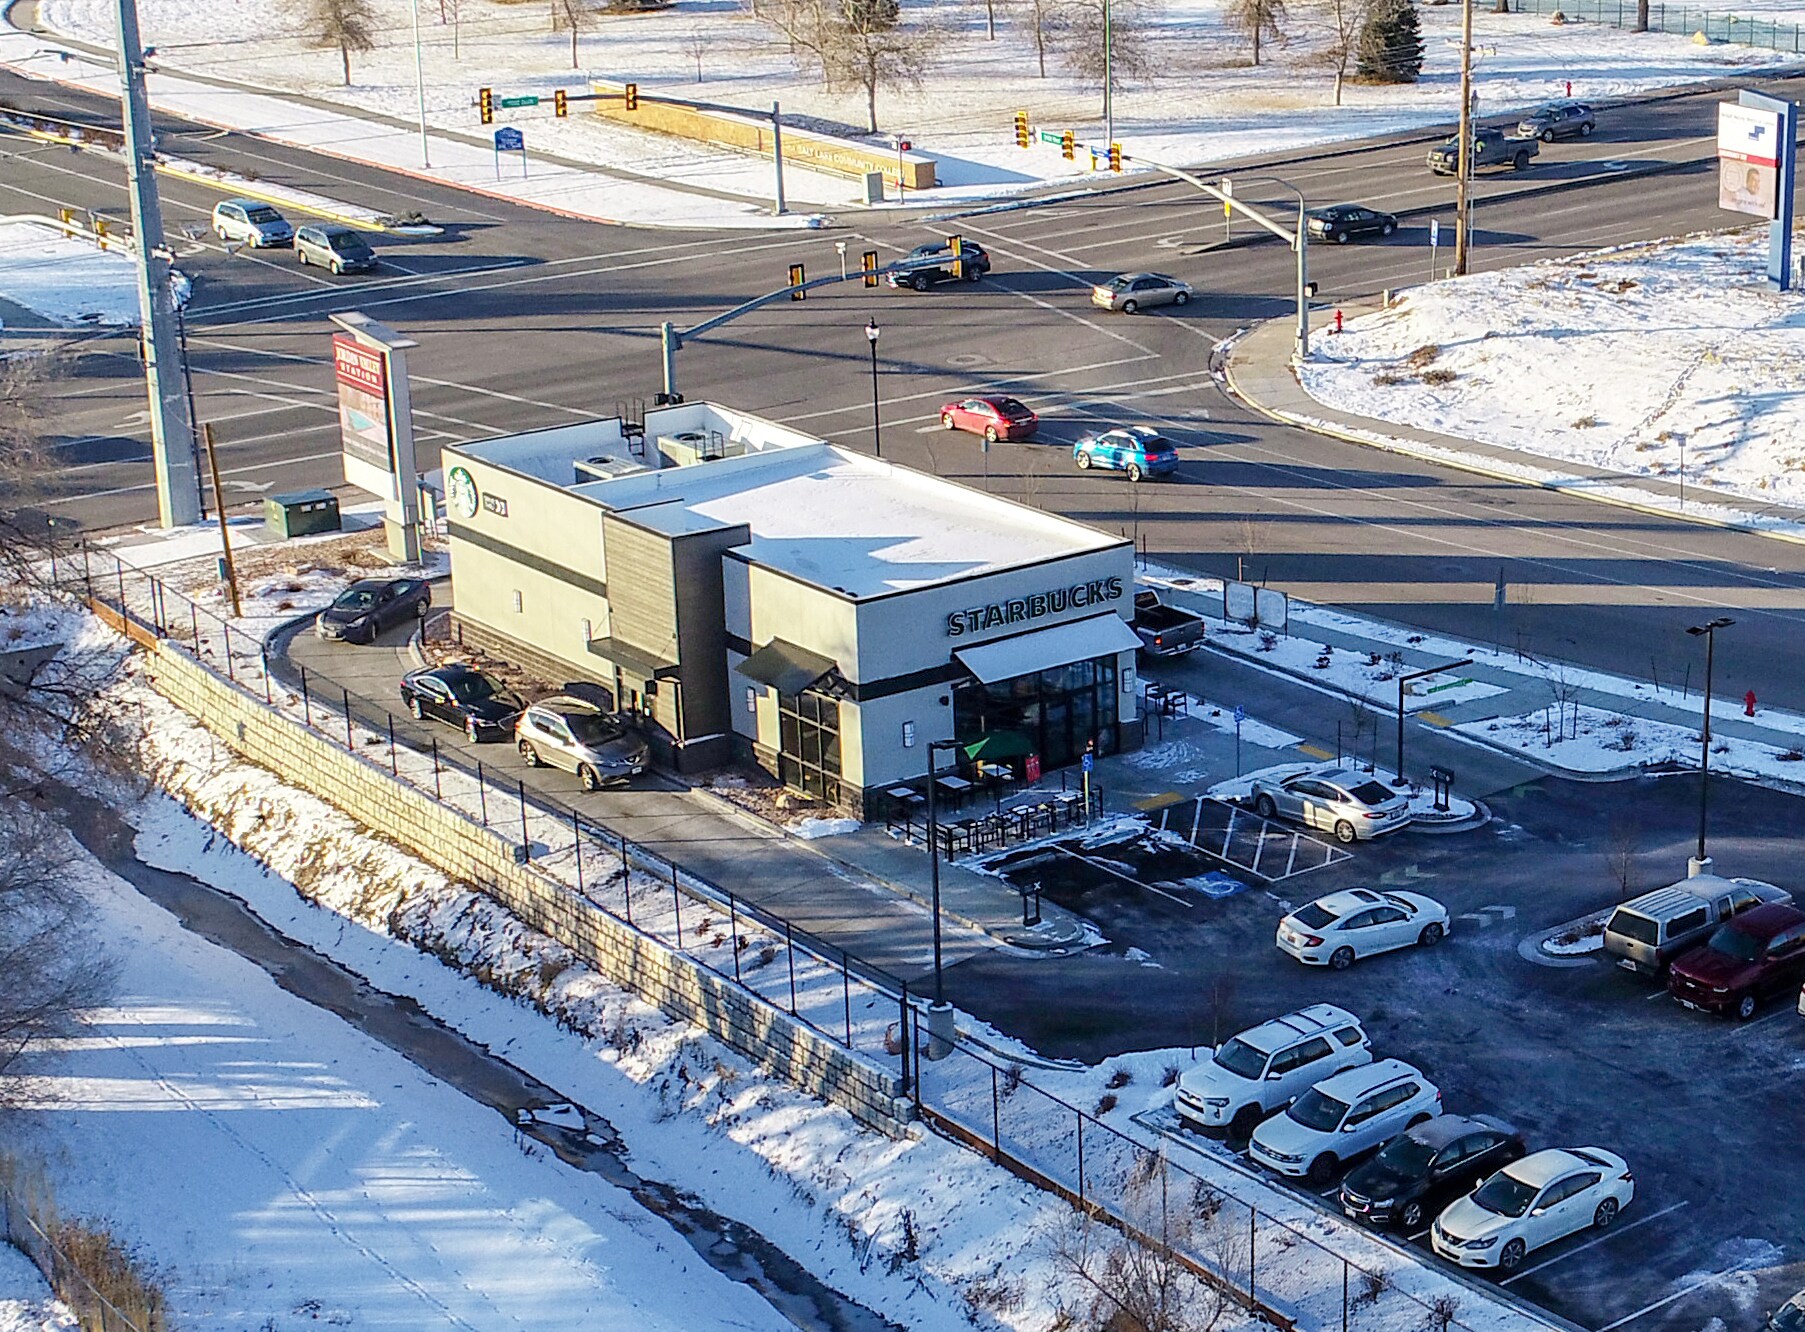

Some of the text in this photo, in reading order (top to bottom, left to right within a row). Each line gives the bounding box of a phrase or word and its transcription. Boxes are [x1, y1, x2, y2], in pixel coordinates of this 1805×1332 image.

[833, 155, 875, 171] COMMUNITY
[340, 362, 378, 383] STATION
[948, 576, 1123, 637] STARBUCKS
